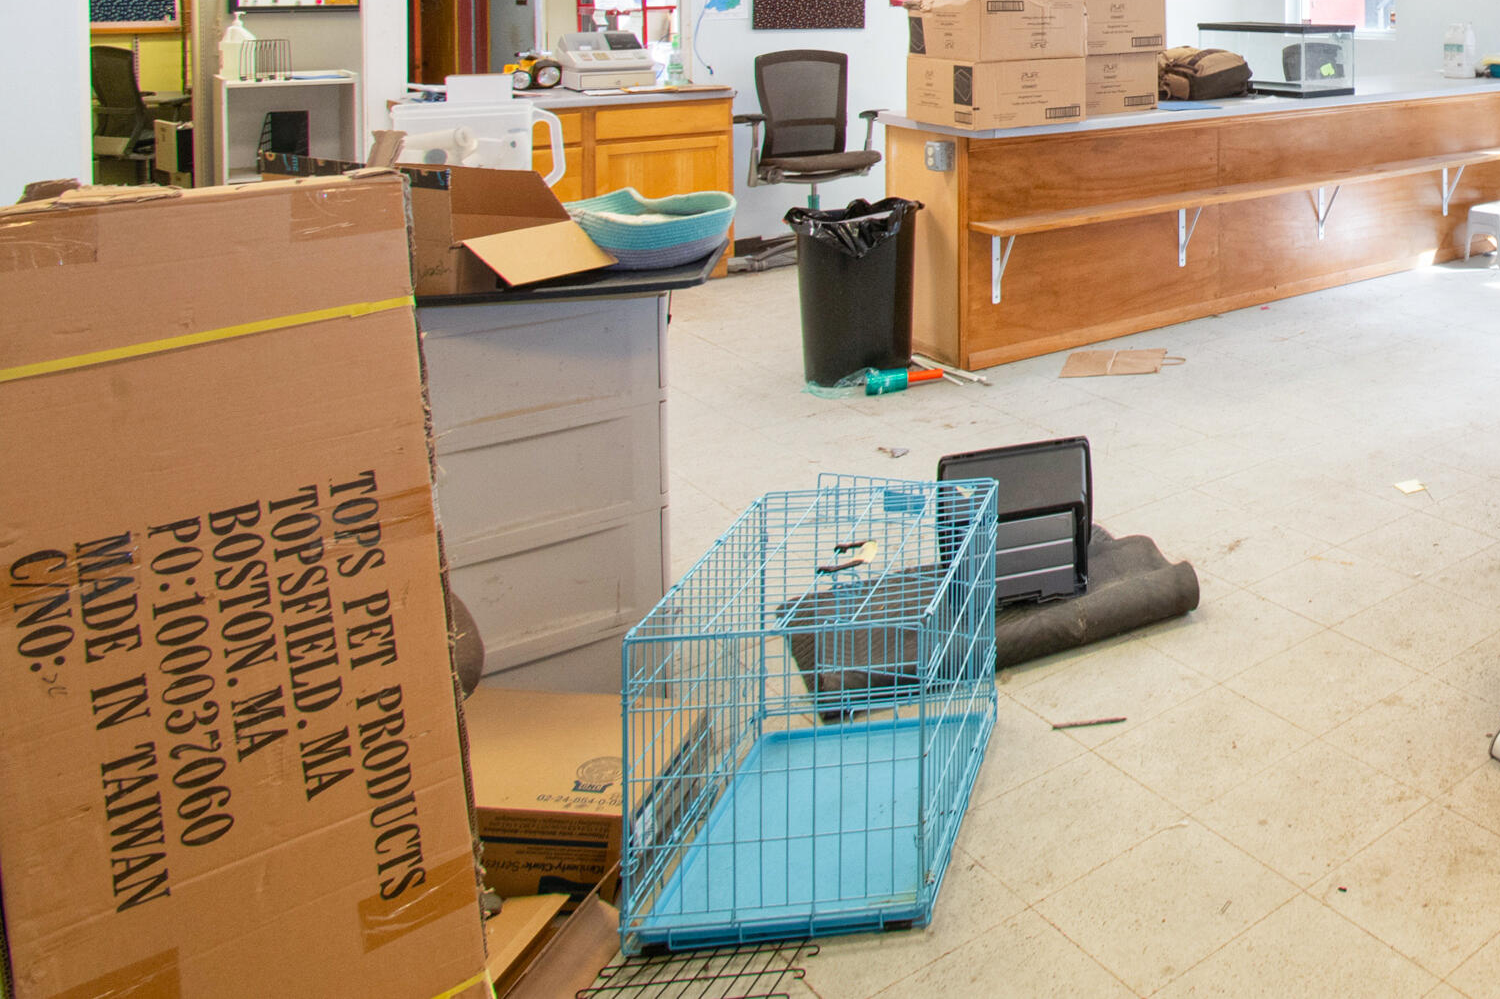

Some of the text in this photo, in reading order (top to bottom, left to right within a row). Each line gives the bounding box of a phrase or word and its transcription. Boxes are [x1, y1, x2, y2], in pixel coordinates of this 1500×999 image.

[9, 549, 75, 673] C/NO:
[74, 531, 171, 913] MADE IN TAIWAN
[147, 516, 235, 848] PO:100037060
[330, 470, 427, 902] TOPS PET PRODUCTS
